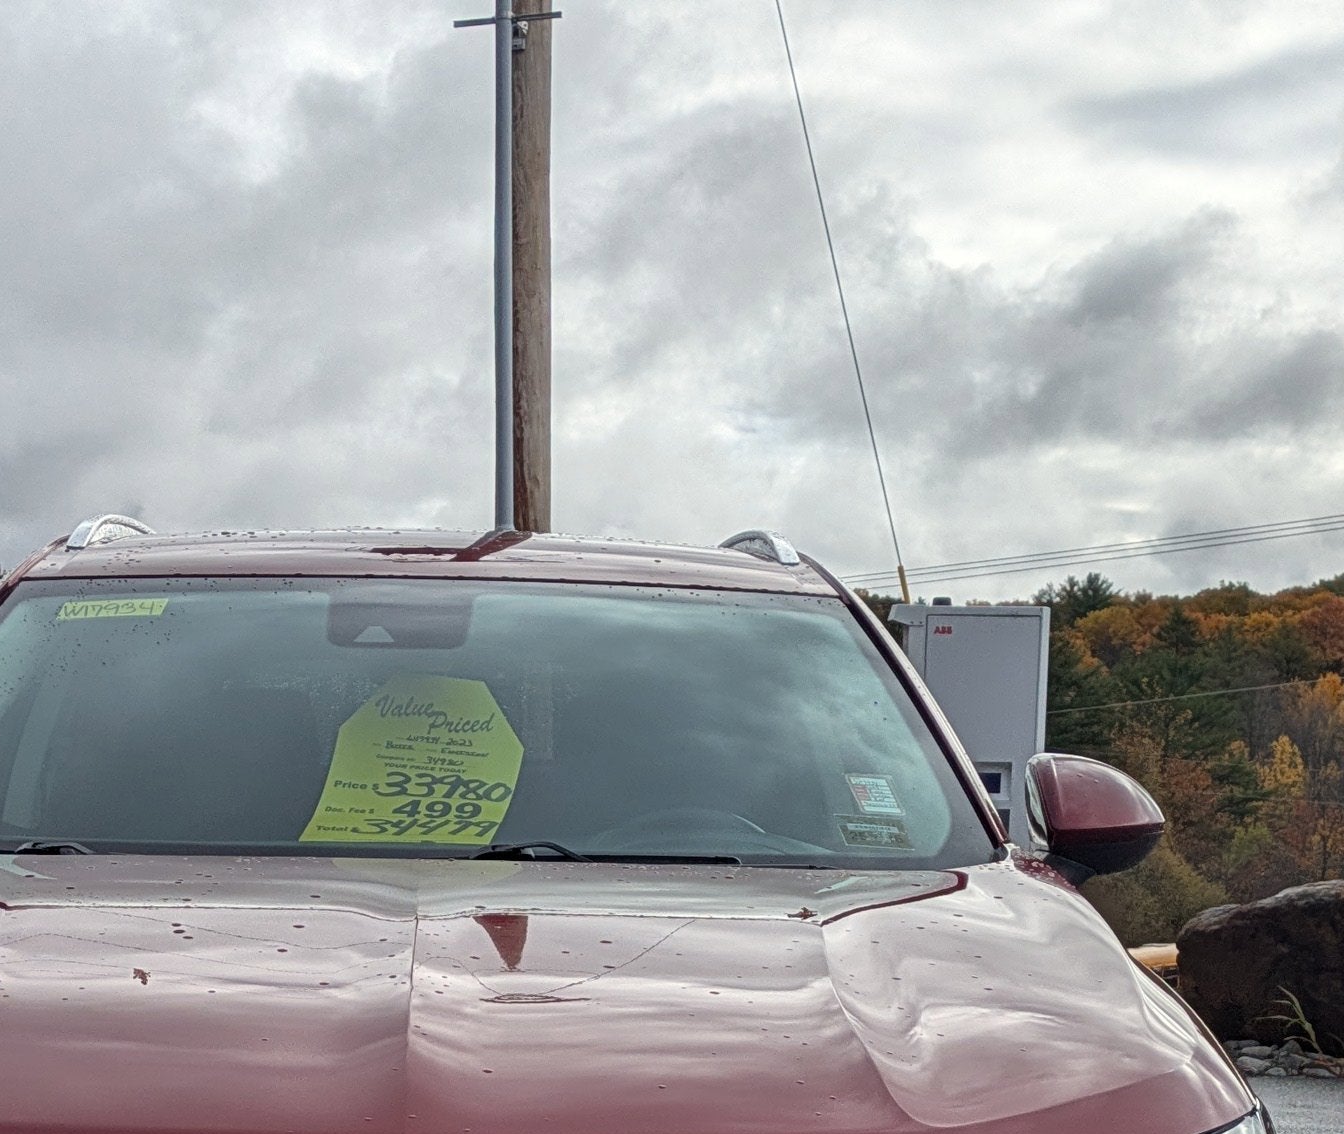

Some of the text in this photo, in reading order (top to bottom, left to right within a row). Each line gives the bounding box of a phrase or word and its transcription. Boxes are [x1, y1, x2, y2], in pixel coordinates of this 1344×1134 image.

[64, 602, 154, 617] W17934
[934, 626, 952, 634] ABB
[375, 694, 435, 718] Value
[428, 711, 495, 734] Priced
[334, 780, 368, 790] Price
[374, 771, 513, 802] 33980
[392, 799, 482, 819] 499
